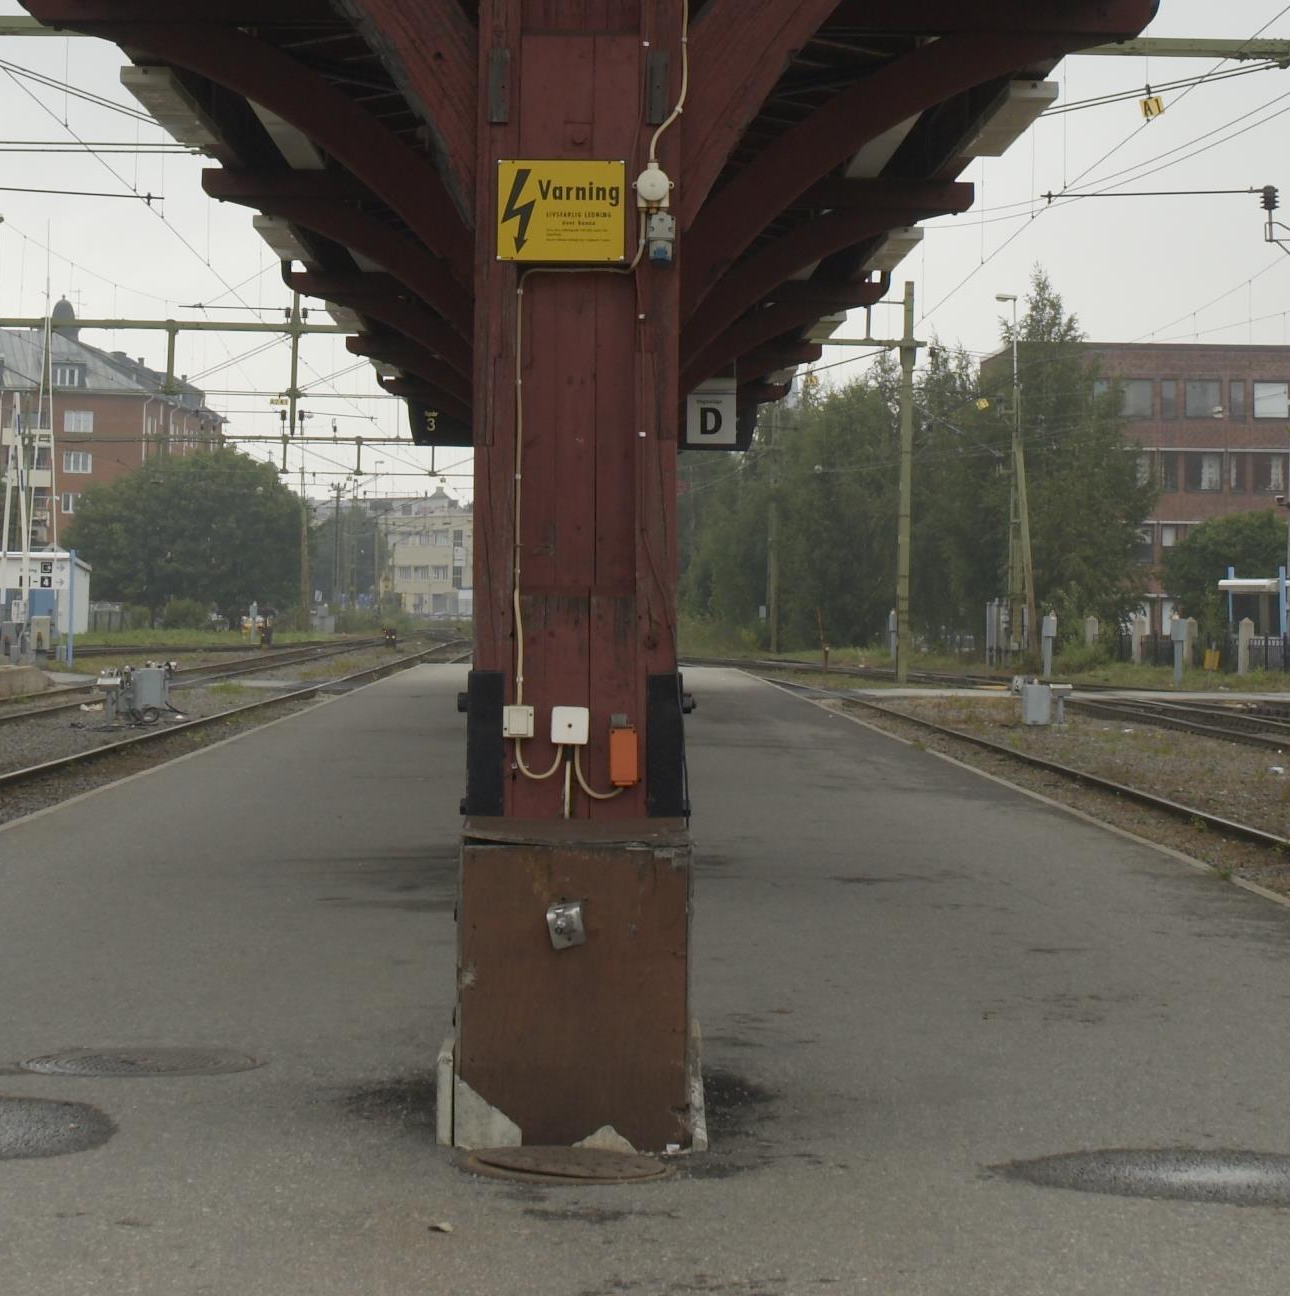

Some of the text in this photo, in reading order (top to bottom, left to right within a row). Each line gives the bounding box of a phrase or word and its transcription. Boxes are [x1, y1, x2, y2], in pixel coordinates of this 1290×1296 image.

[1143, 98, 1162, 116] A1
[537, 179, 620, 207] Varning
[426, 417, 436, 432] 3
[700, 407, 722, 435] D
